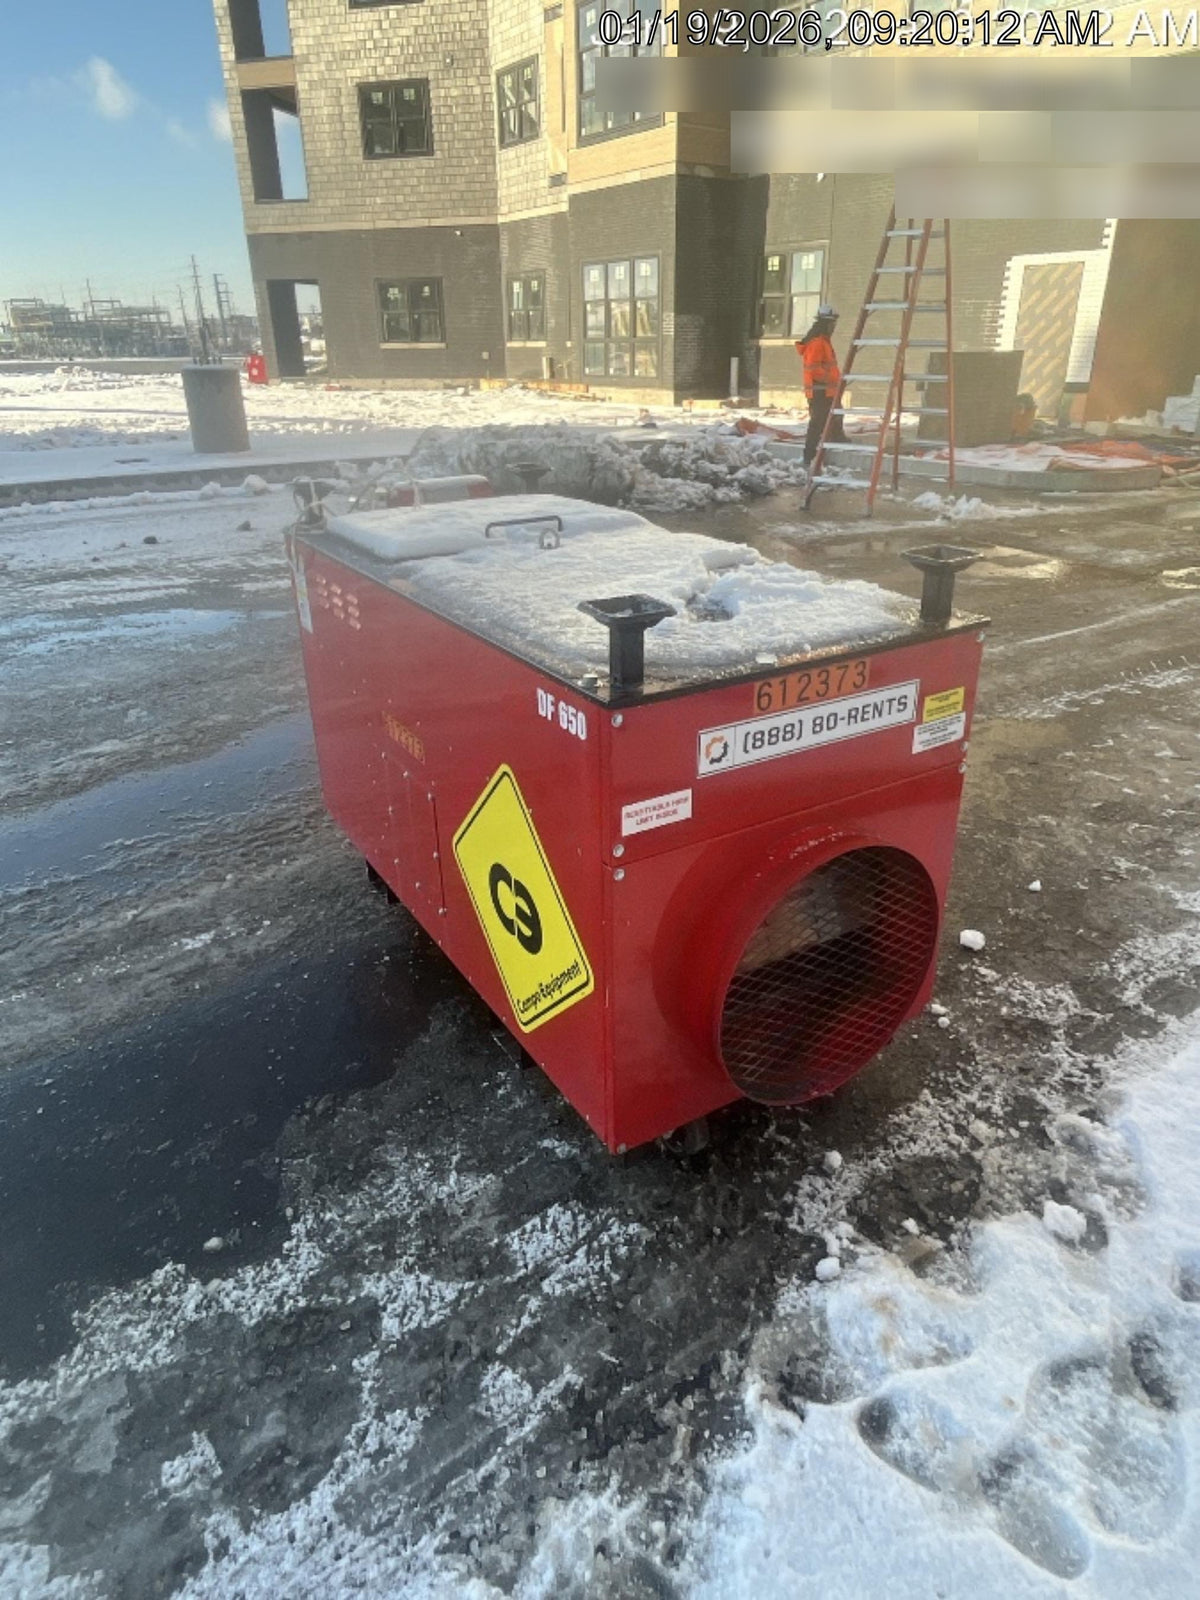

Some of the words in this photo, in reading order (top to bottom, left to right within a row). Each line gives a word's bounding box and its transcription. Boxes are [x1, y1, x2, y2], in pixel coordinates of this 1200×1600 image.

[756, 660, 867, 712] 612373
[536, 687, 555, 721] DF
[558, 700, 587, 740] 650
[743, 719, 804, 754] (888)
[811, 694, 908, 735] 80-RENTS
